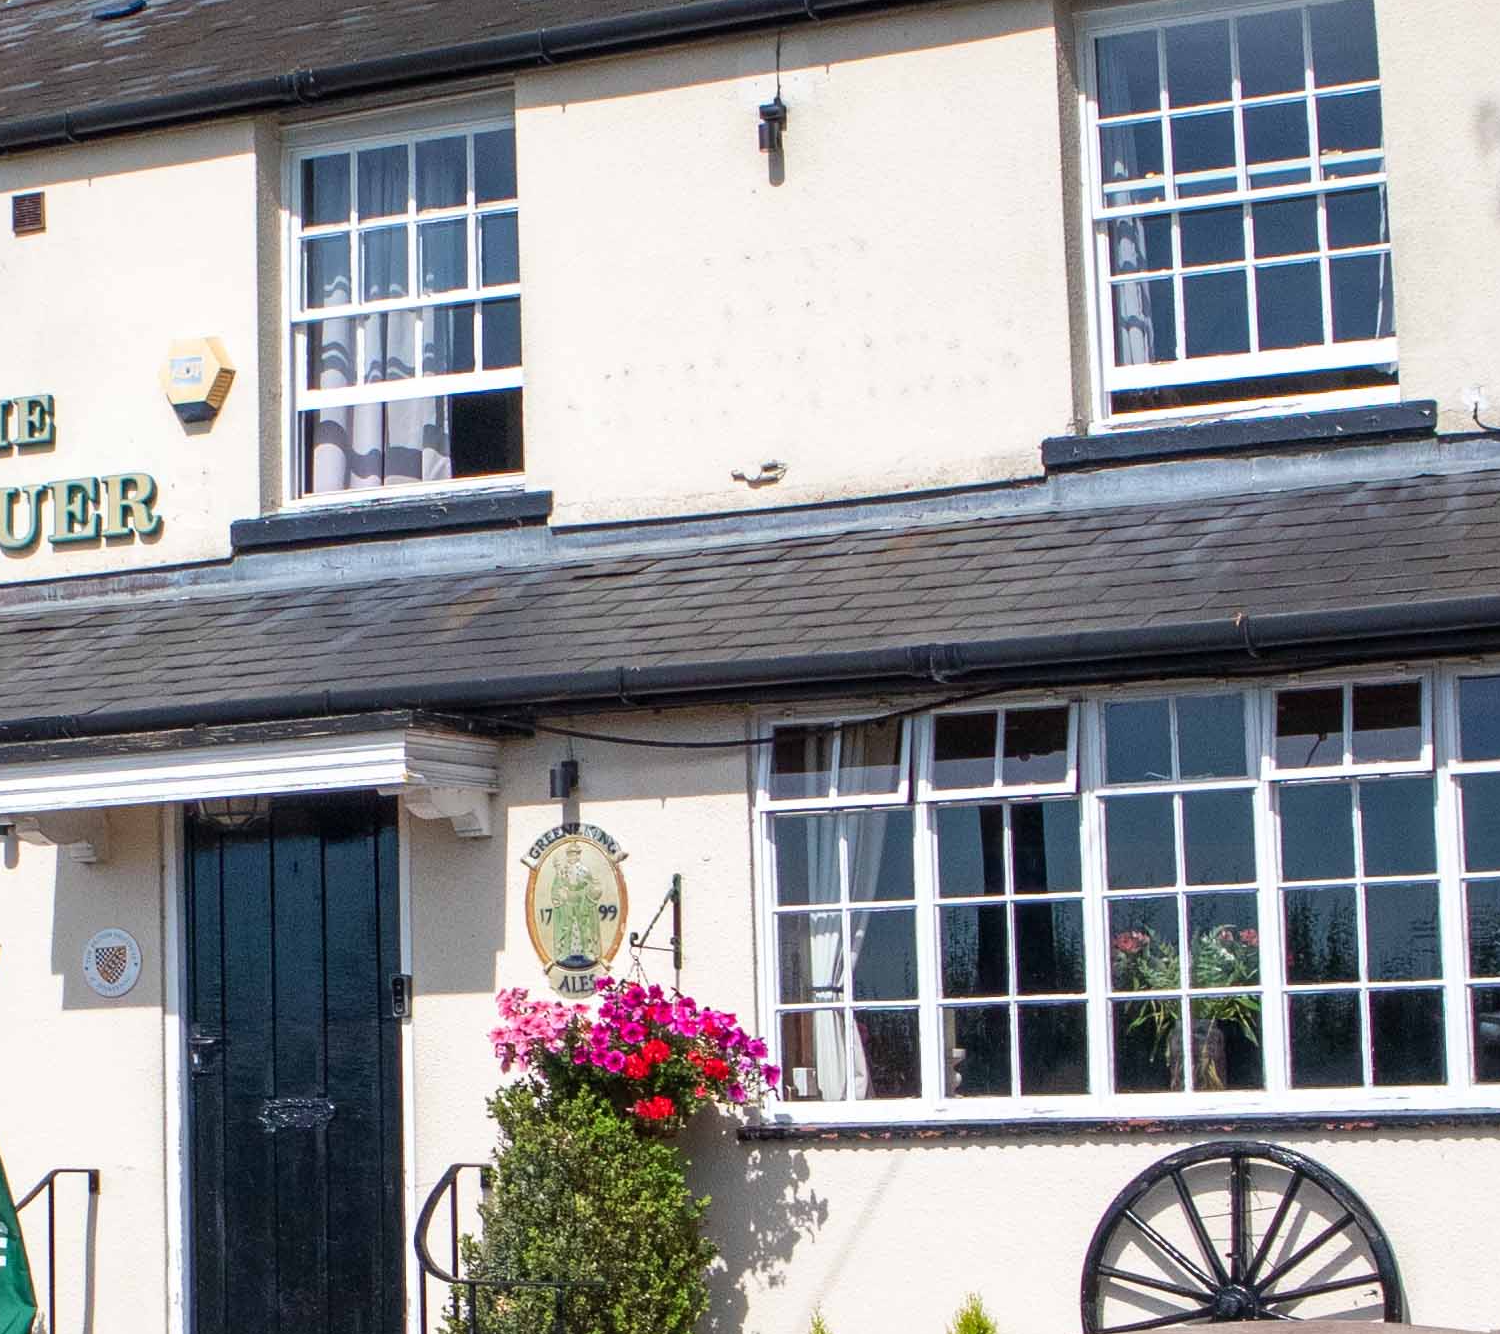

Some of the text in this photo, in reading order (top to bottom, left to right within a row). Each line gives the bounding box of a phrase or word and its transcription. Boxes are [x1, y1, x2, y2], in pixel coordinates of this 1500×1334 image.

[528, 822, 617, 860] GREENE KING
[540, 904, 617, 925] 17 99
